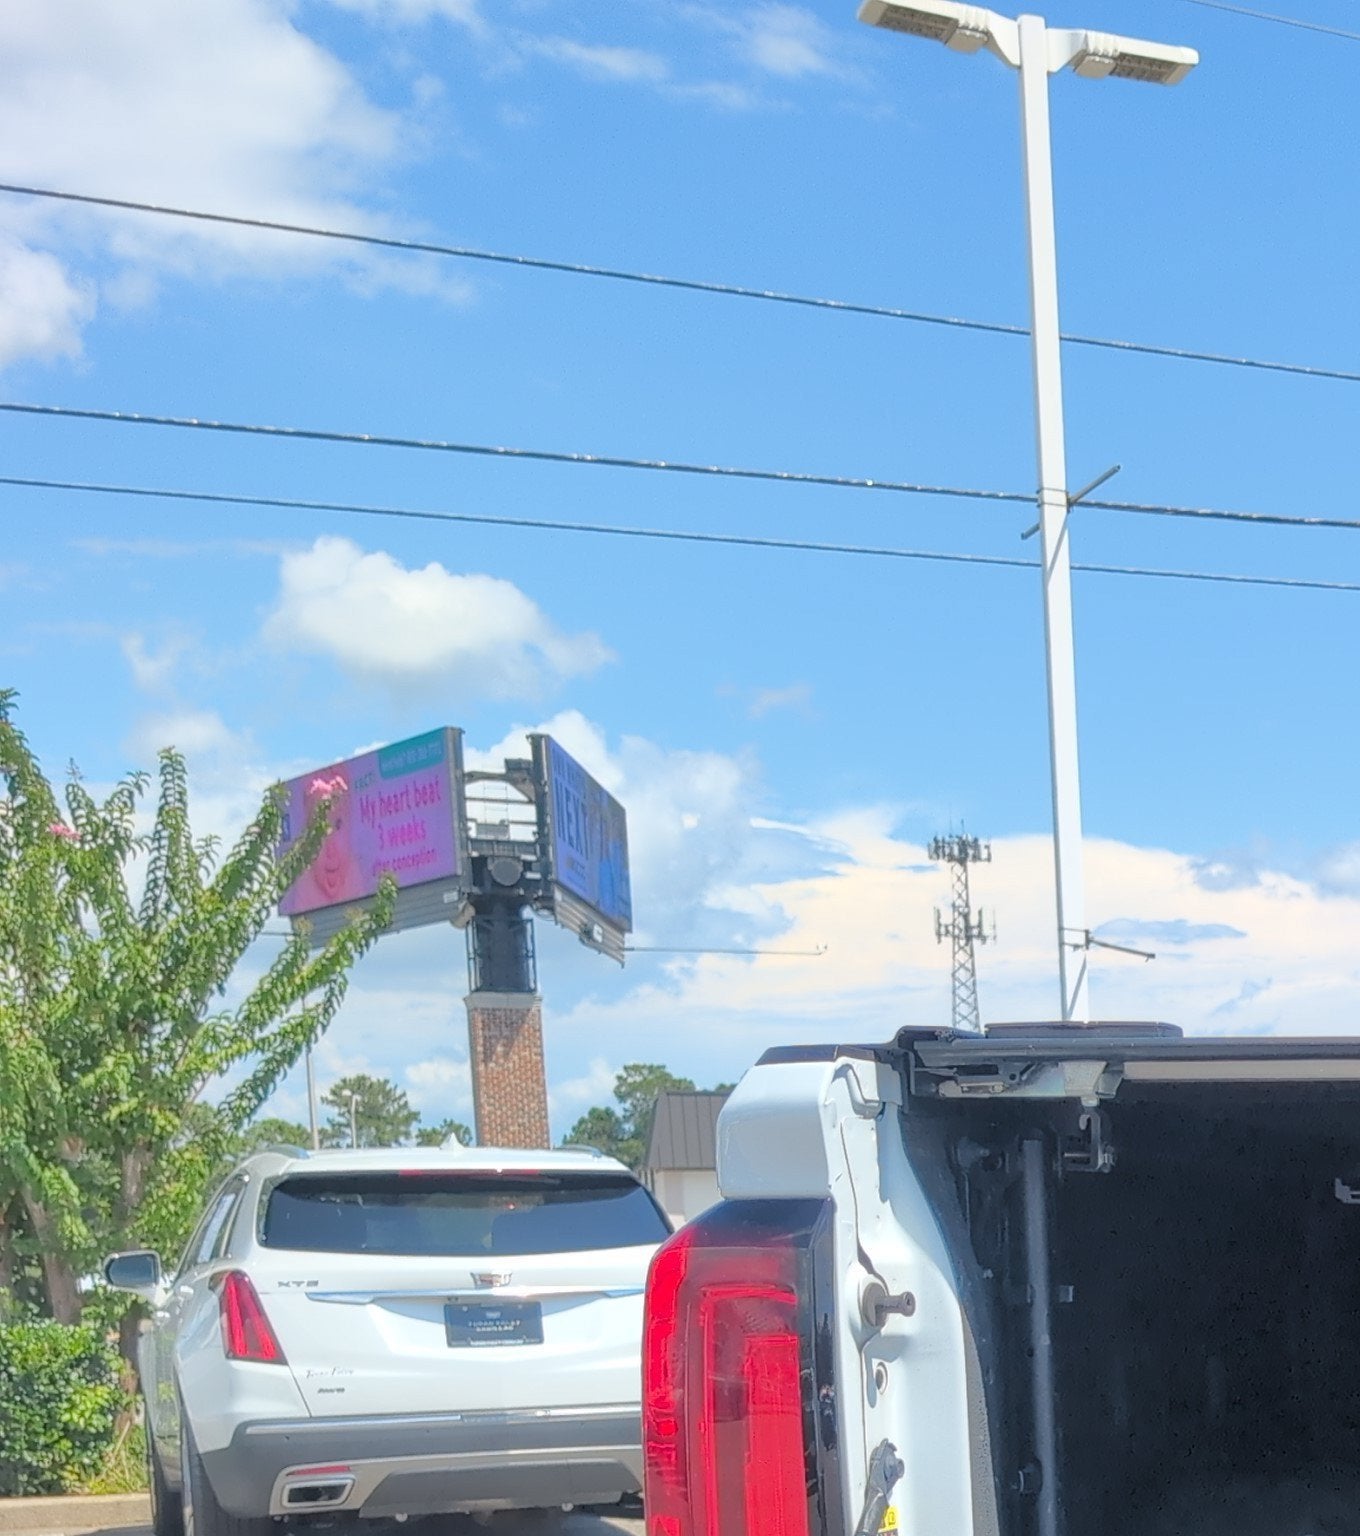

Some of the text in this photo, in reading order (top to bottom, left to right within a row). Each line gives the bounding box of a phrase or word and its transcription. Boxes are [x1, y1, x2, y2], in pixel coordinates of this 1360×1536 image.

[378, 783, 411, 816] heart
[413, 775, 441, 808] beat
[387, 814, 426, 847] weeks
[392, 847, 437, 873] conception
